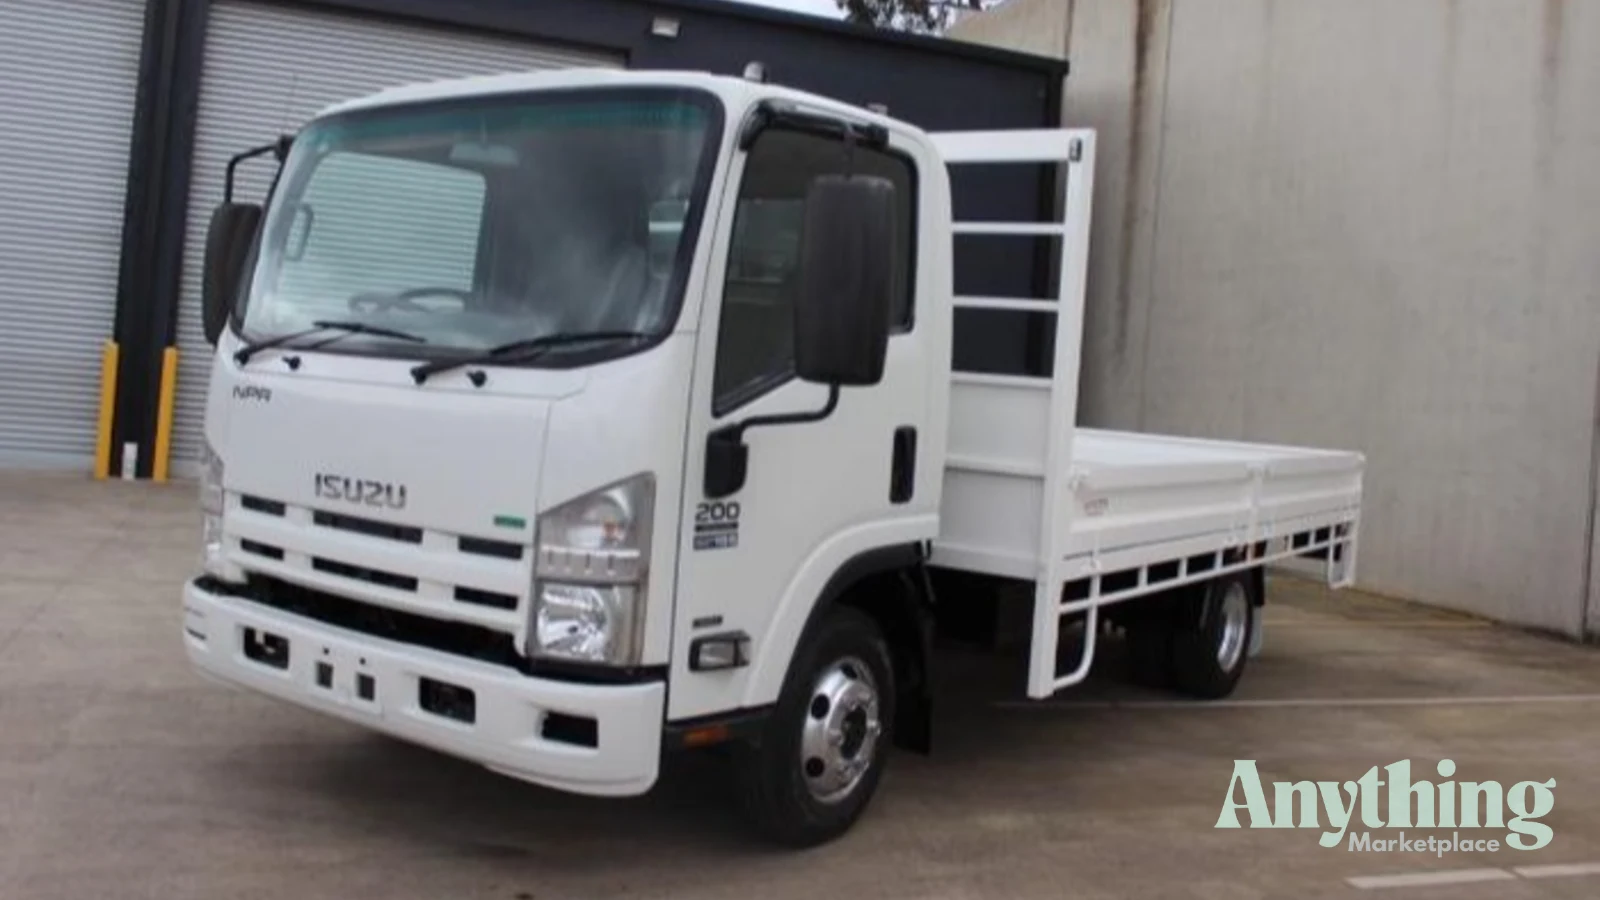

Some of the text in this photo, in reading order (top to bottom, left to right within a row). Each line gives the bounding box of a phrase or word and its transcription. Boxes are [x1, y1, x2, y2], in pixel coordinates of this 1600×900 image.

[232, 385, 272, 402] NPR
[313, 472, 406, 509] ISUZU
[694, 501, 740, 521] 200
